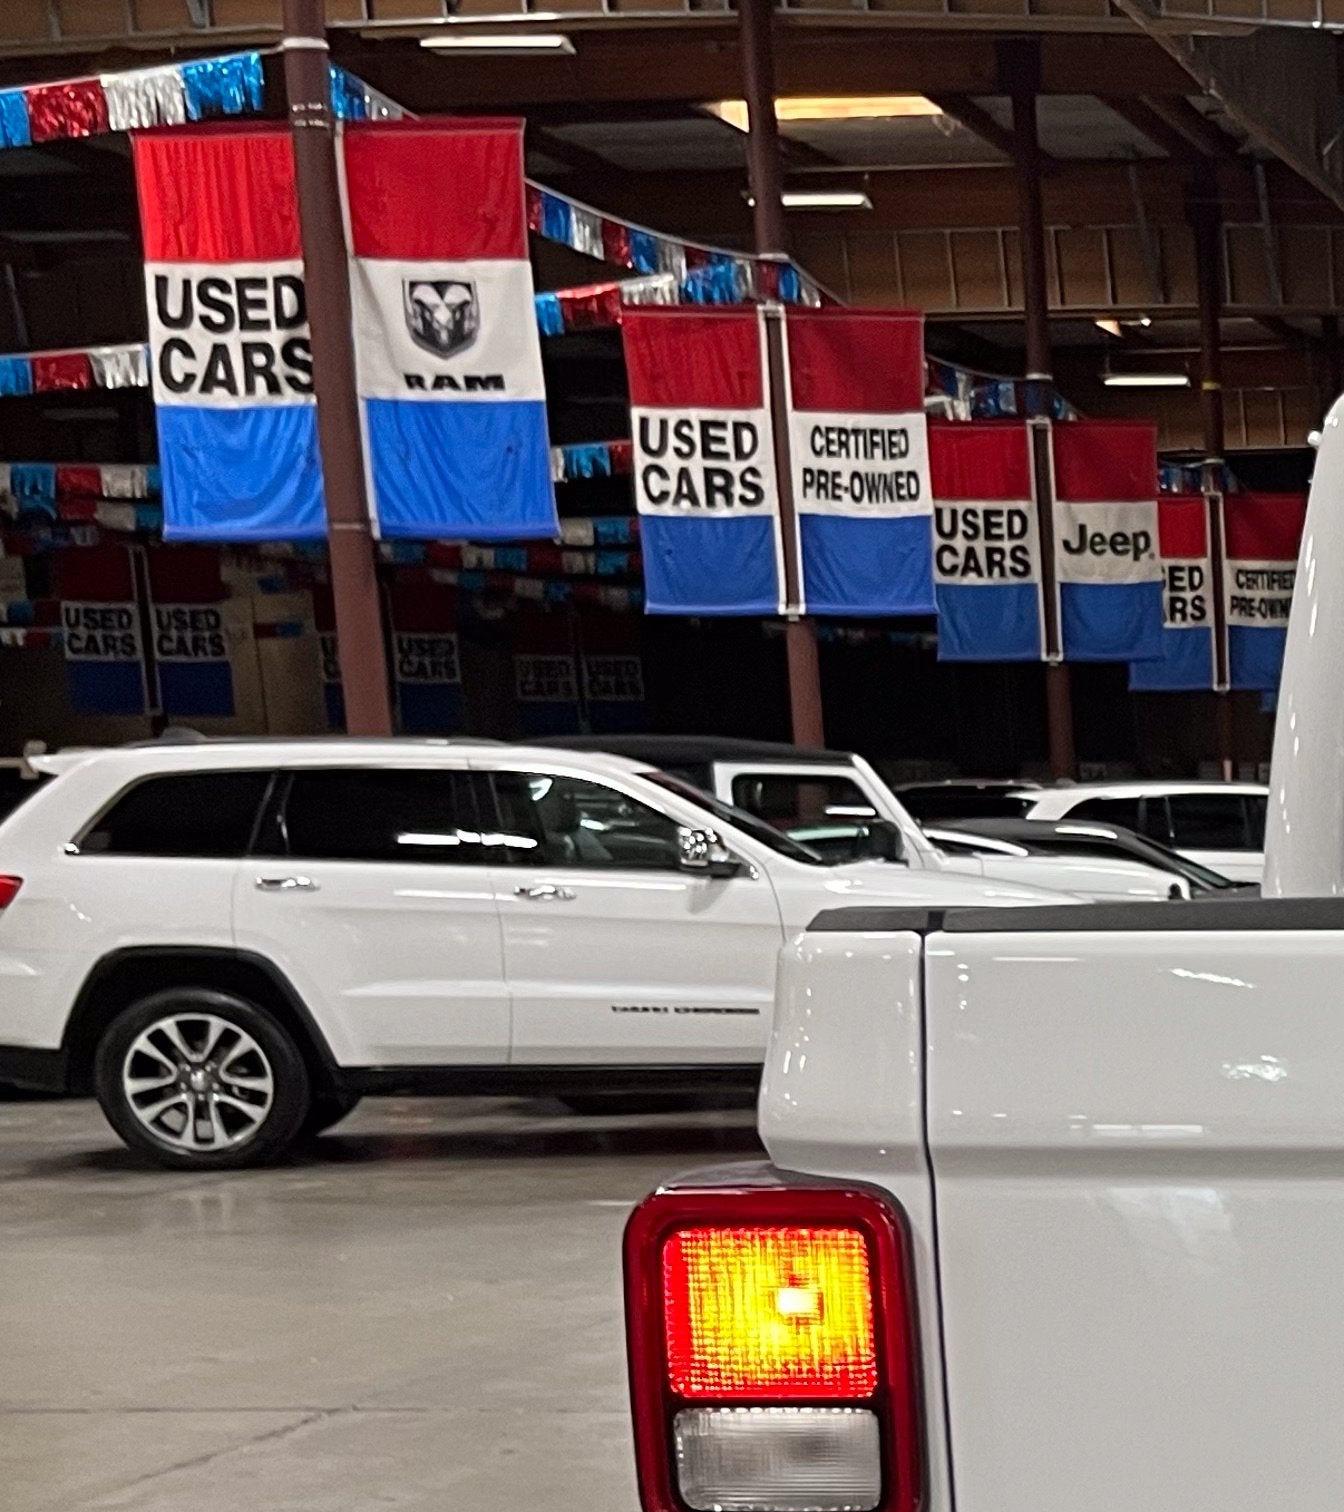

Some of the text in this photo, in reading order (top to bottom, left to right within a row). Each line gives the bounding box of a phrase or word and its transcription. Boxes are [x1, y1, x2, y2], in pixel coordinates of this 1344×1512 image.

[154, 274, 308, 332] USED
[158, 337, 315, 396] CARS
[403, 373, 507, 392] RAM
[638, 415, 759, 462] USED
[809, 424, 910, 461] CERTIFIED
[641, 463, 766, 508] CARS
[802, 467, 921, 504] PRE-OWNED
[934, 507, 1029, 542] USED
[1061, 523, 1151, 562] Jeep
[935, 543, 1032, 578] CARS
[1167, 565, 1204, 592] ED
[65, 606, 133, 631] USED
[156, 608, 220, 631] USED
[1168, 595, 1207, 622] RS
[67, 633, 137, 657] CARS
[157, 633, 225, 657] CARS
